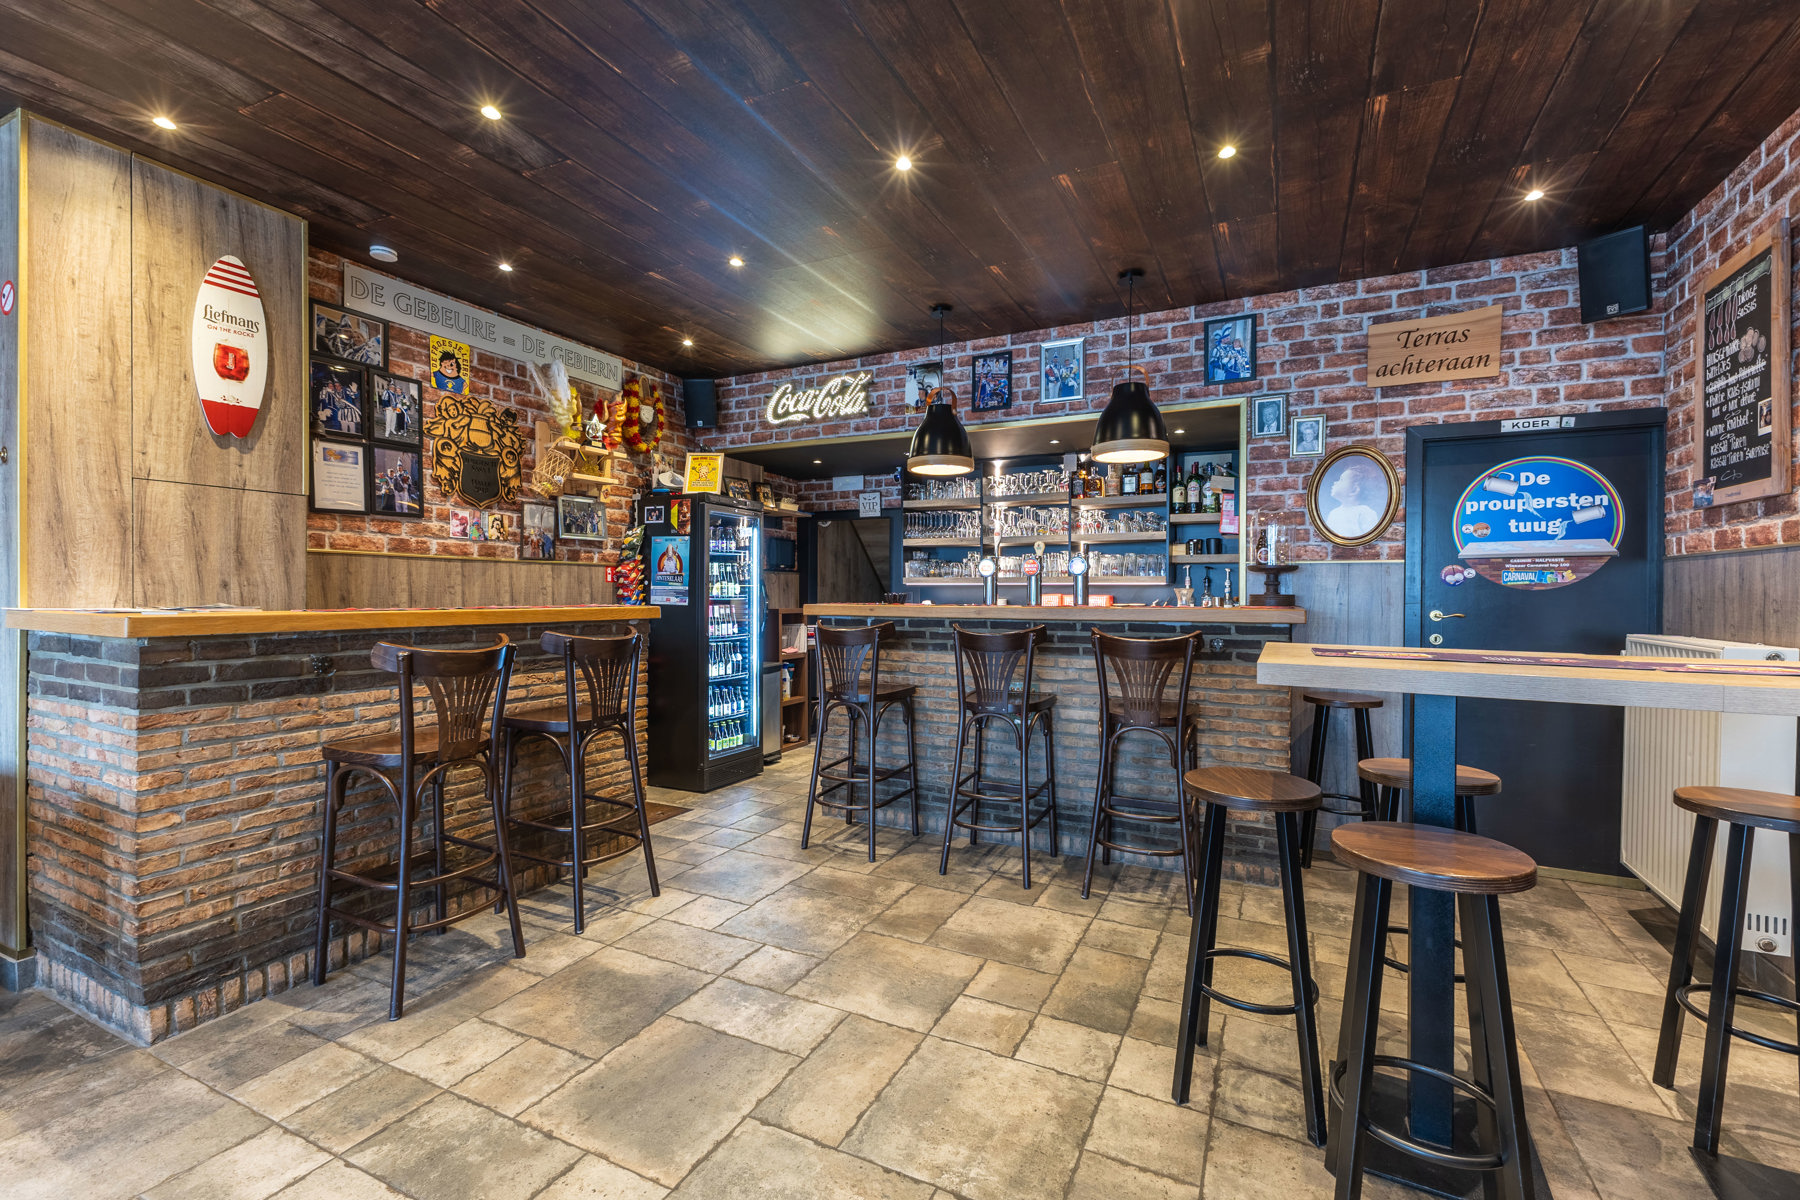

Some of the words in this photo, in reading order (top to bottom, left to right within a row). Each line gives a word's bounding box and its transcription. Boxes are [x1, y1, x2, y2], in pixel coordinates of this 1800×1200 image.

[203, 304, 260, 333] Liefmans
[233, 330, 255, 338] ROCKS
[351, 276, 385, 307] DE
[393, 292, 497, 342] GEBEURE
[522, 334, 545, 358] DE
[551, 346, 618, 381] GEBIERN
[1396, 328, 1470, 349] Terras
[432, 357, 438, 368] DE
[1376, 354, 1491, 378] achteraan
[767, 371, 872, 425] Coca-Cola
[1512, 420, 1550, 429] KOER
[1520, 472, 1550, 486] De
[862, 502, 878, 510] VIP
[1465, 493, 1609, 514] proupersten
[1508, 518, 1562, 534] tuug
[1504, 572, 1536, 582] CARNAVAL
